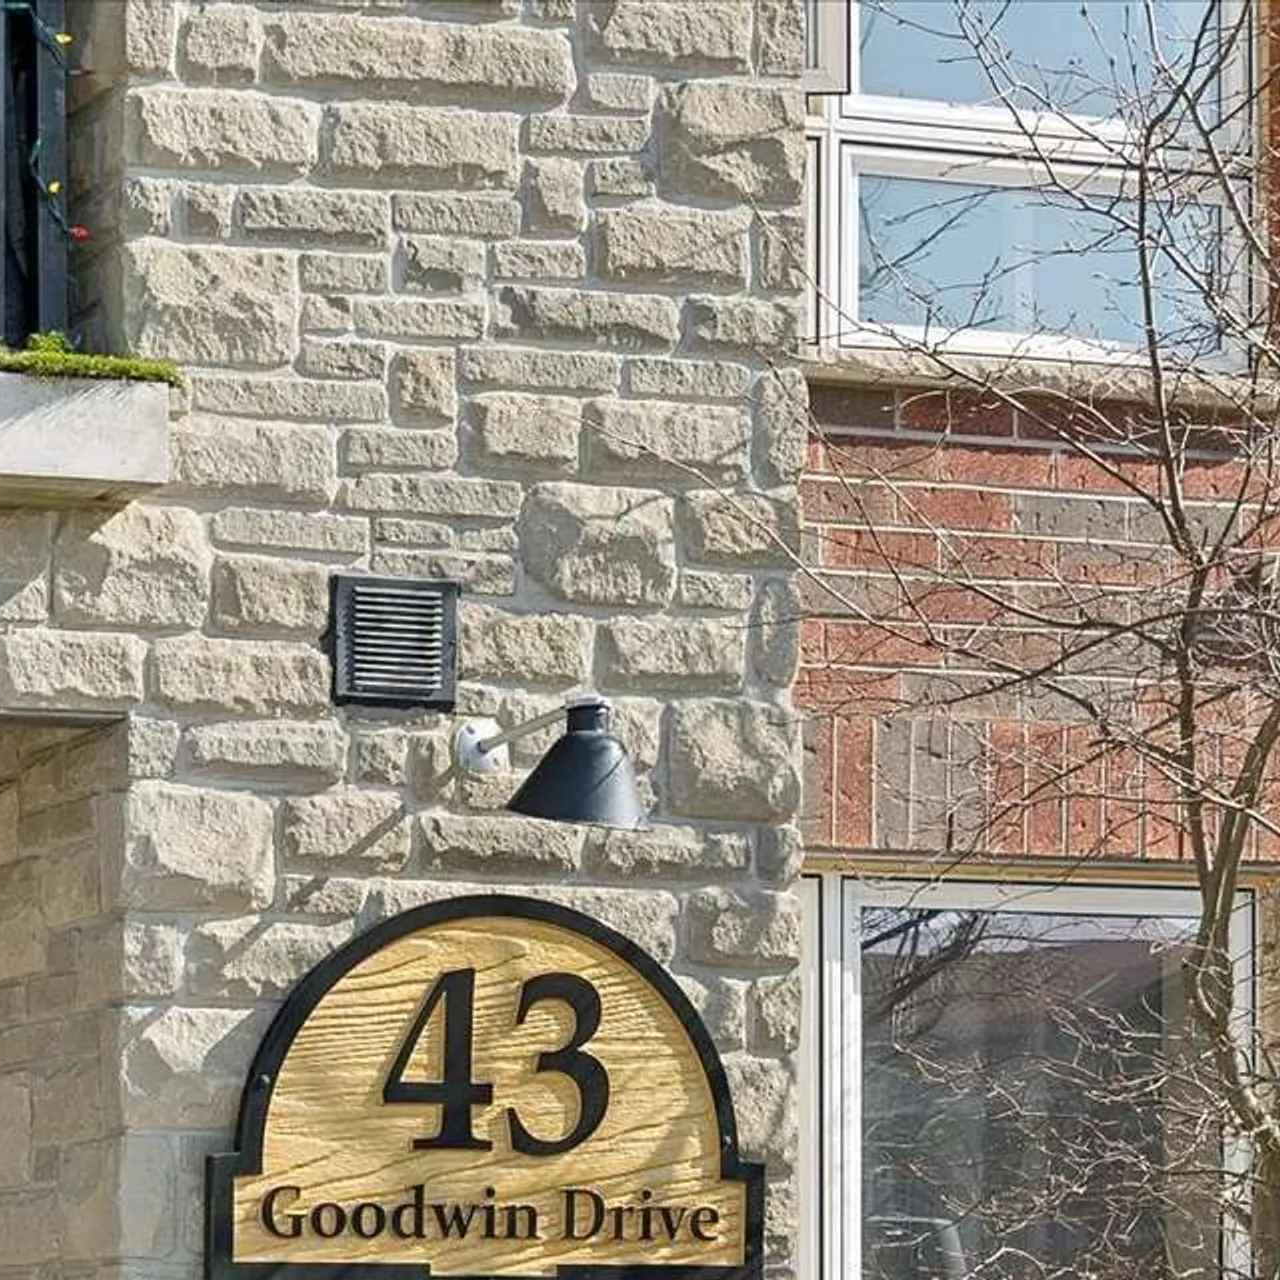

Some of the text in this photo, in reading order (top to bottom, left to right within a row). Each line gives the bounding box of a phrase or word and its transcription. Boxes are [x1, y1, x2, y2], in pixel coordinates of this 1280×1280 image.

[382, 967, 610, 1157] 43
[261, 1184, 720, 1243] Goodwin Drive
